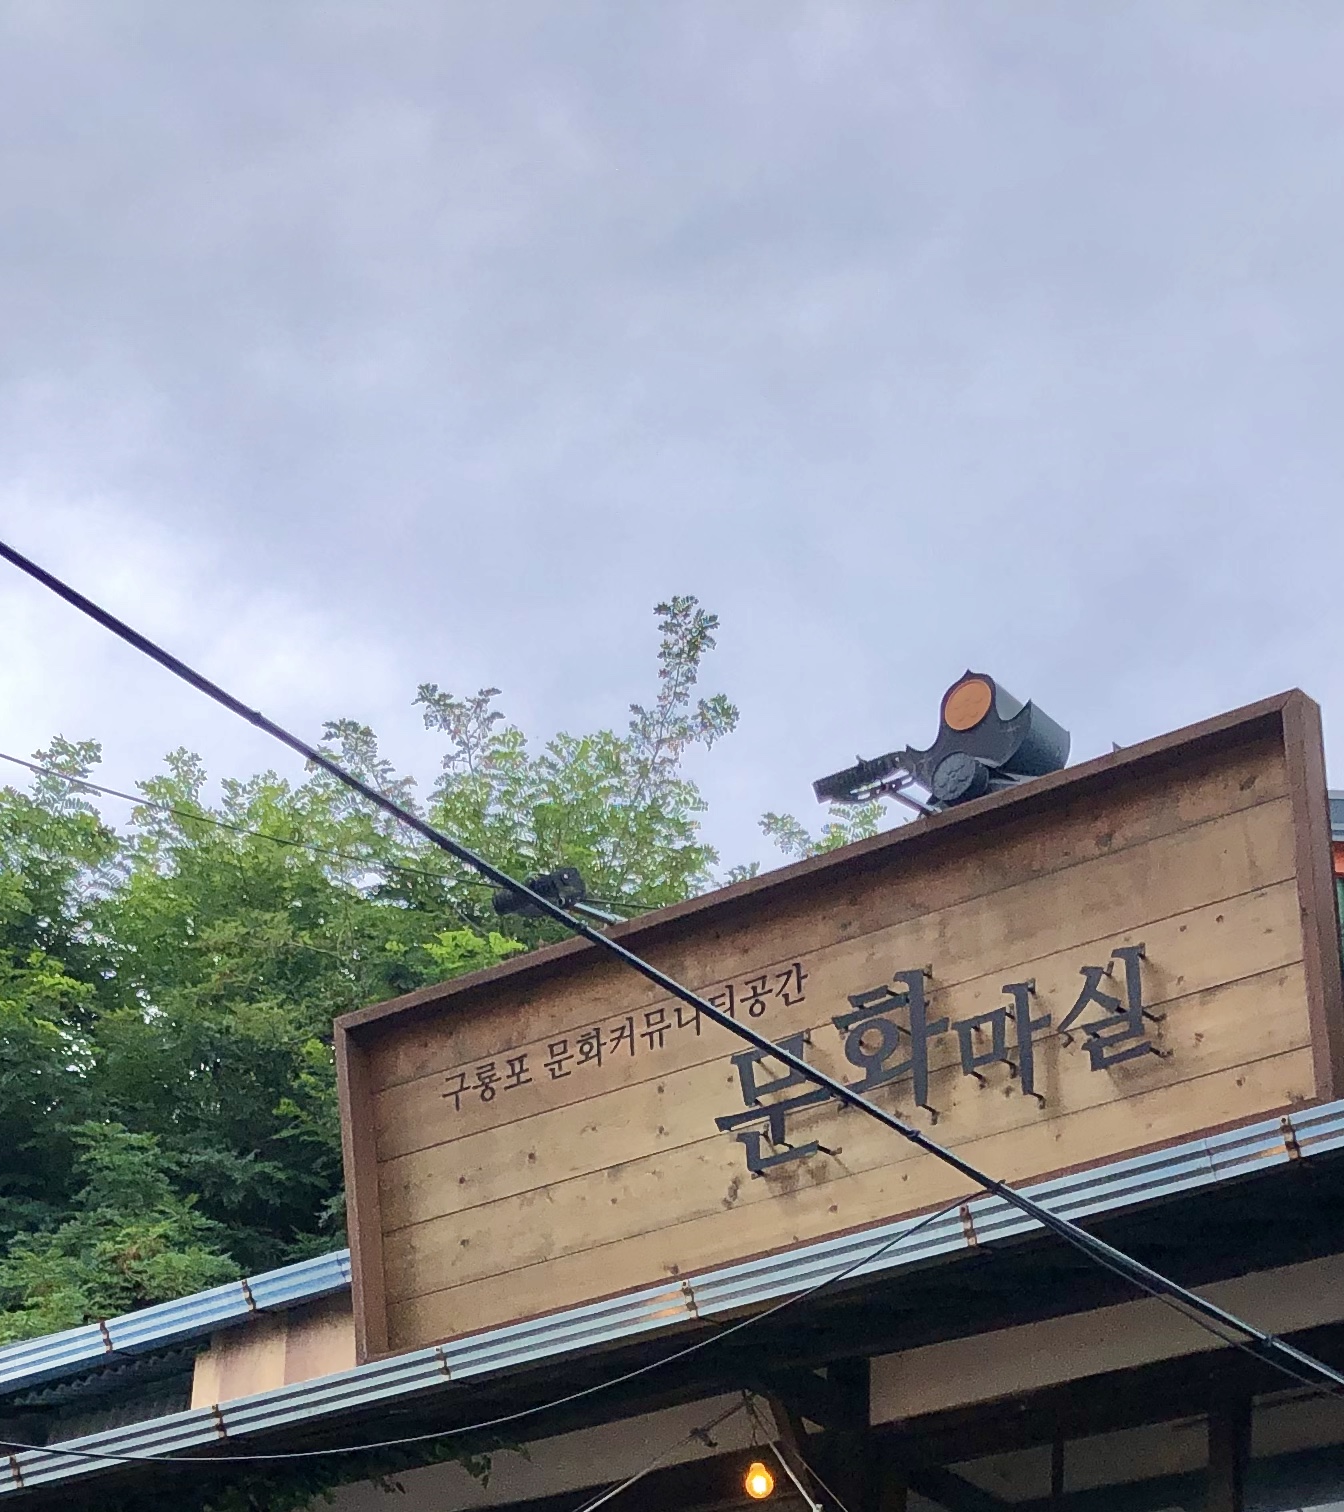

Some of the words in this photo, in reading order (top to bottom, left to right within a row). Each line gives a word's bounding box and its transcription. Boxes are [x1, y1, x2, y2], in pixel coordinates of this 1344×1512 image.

[442, 1053, 532, 1111] 구룡포
[543, 962, 809, 1081] 문화커뮤니티공간
[714, 942, 1146, 1174] 문화마실
